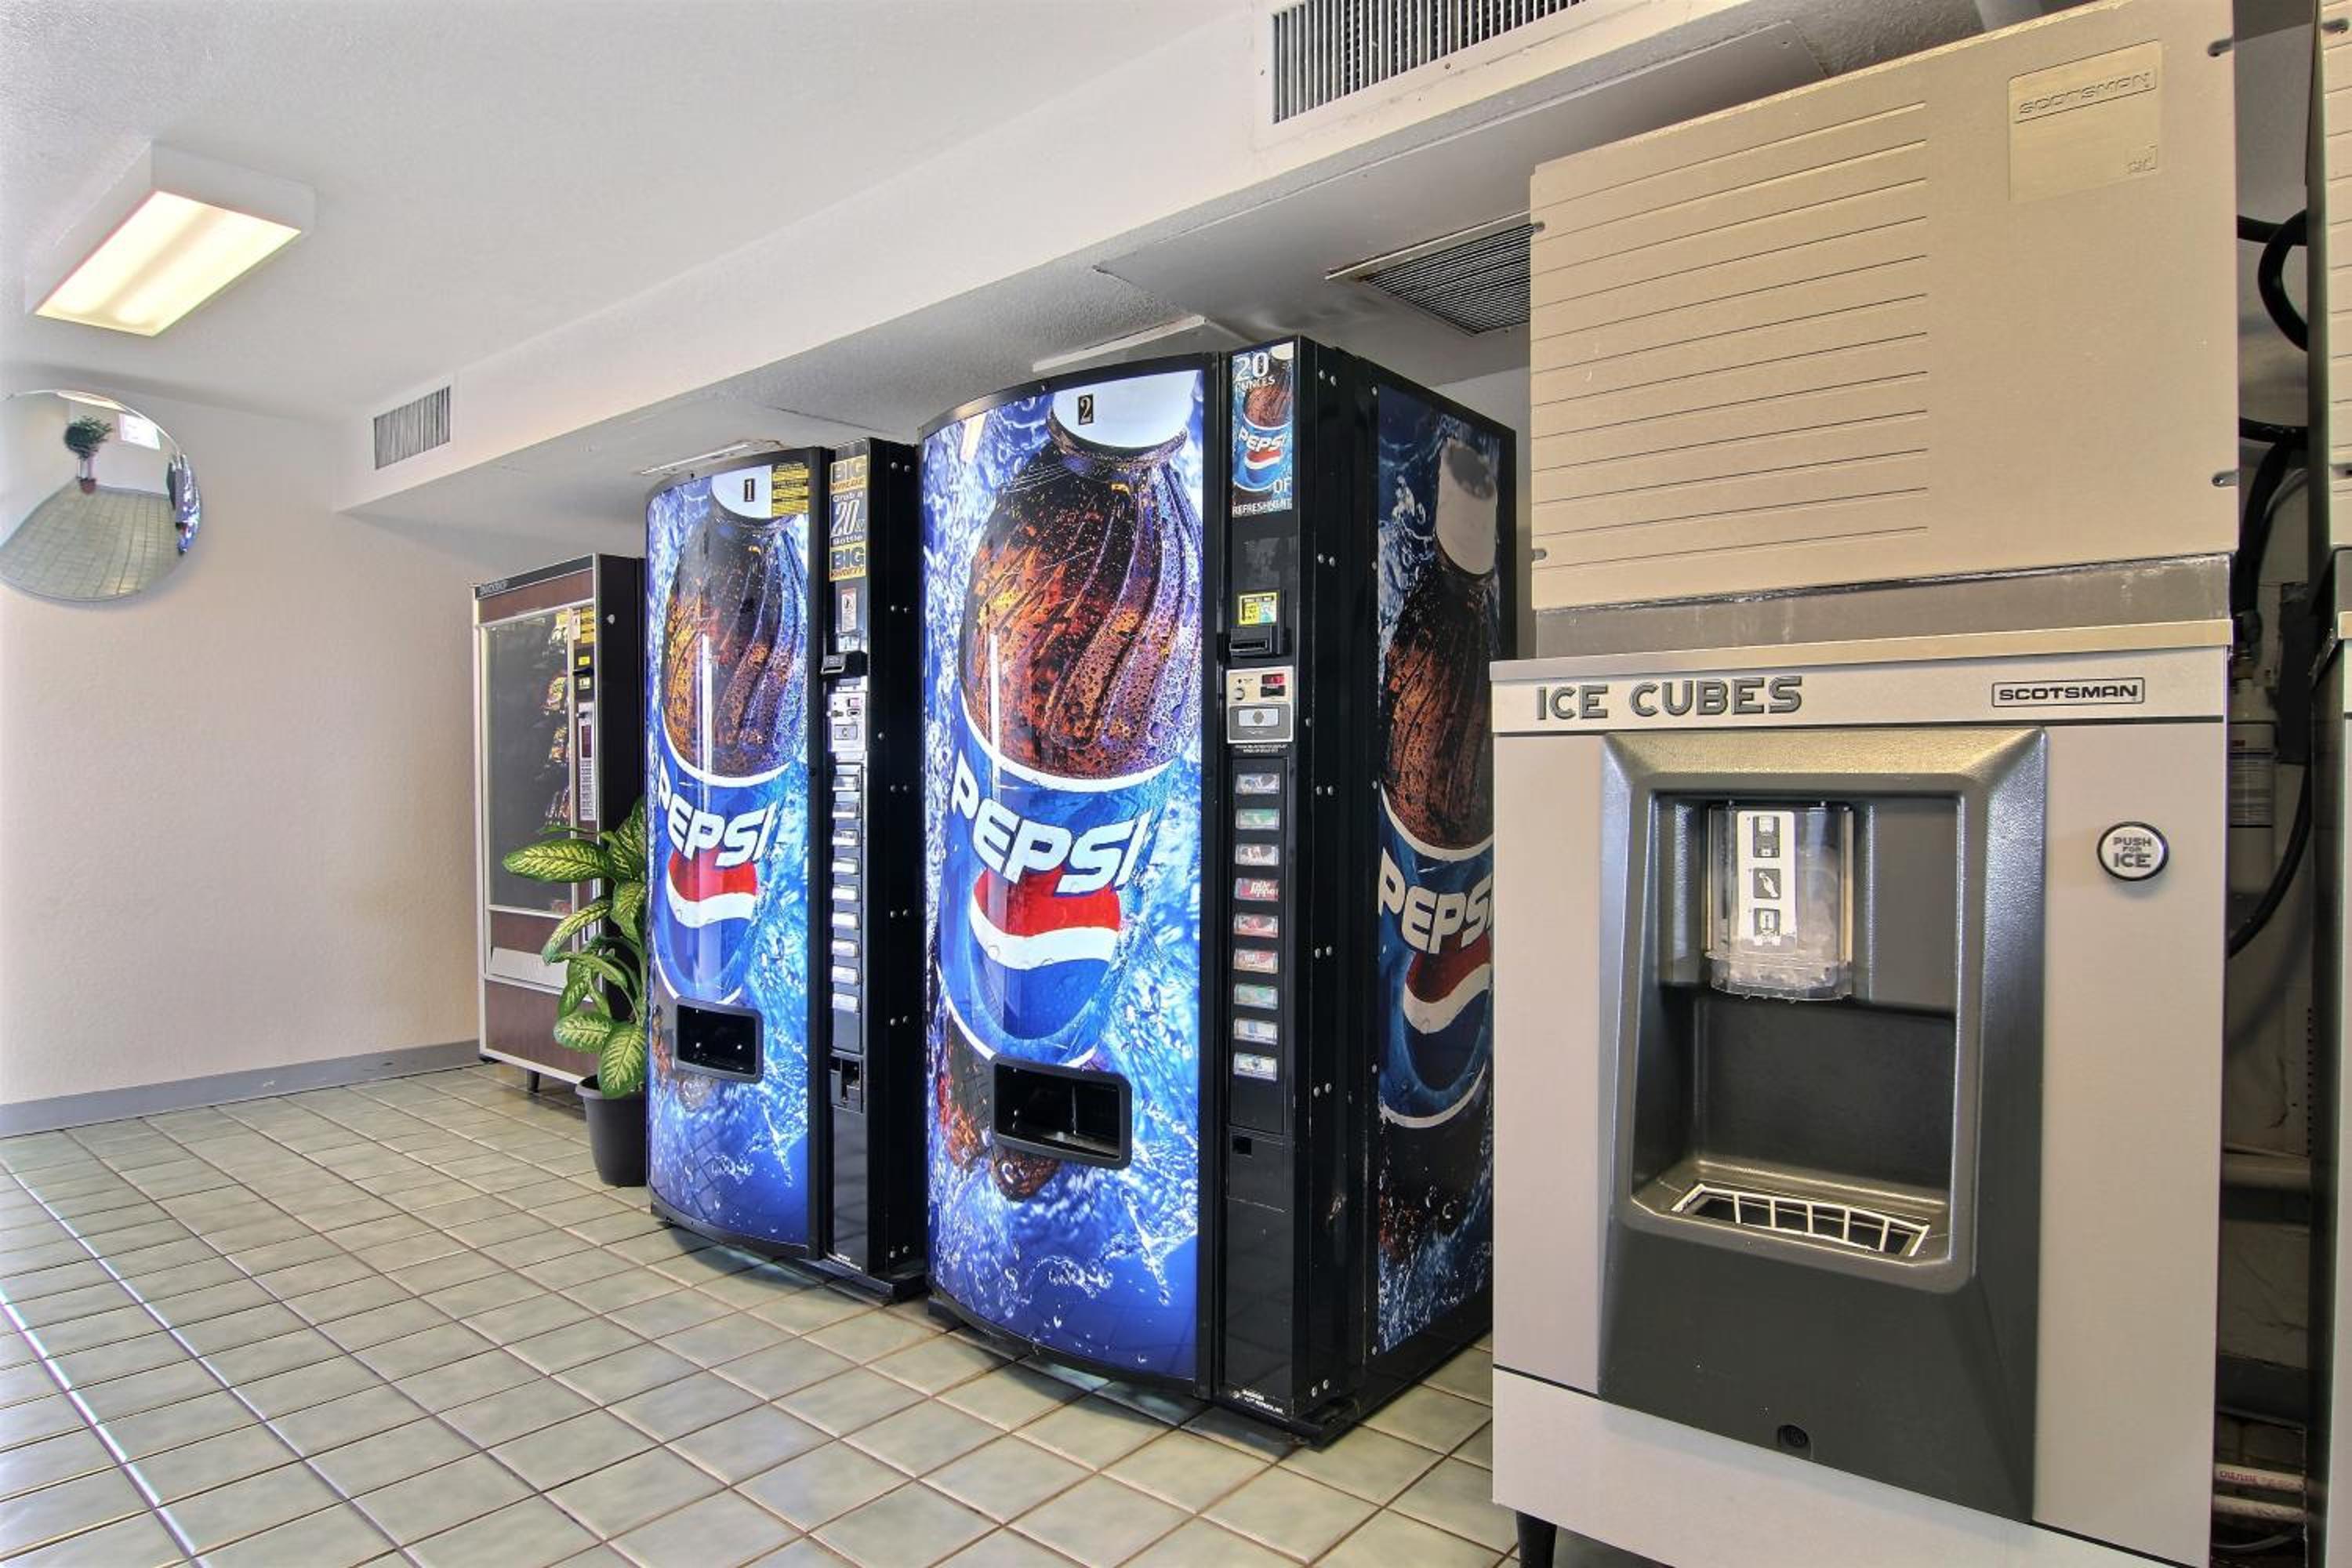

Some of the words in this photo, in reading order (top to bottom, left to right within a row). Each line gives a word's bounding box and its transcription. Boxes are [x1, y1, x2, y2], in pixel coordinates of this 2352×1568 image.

[2019, 72, 2151, 114] SCOTSMAN
[1235, 352, 1269, 382] 20
[1079, 396, 1092, 424] 2
[1238, 426, 1286, 452] PEPSI
[832, 459, 866, 483] BIG
[745, 480, 753, 501] 1
[1272, 477, 1292, 494] OF
[831, 499, 860, 537] 20
[831, 547, 865, 570] BIG
[1537, 684, 1608, 720] ICE
[1630, 676, 1802, 717] CUBES
[1999, 684, 2139, 701] SCOTSMAN
[658, 755, 779, 866] PEPSI
[951, 749, 1153, 894] PEPSI
[2113, 837, 2151, 847] PUSH
[2114, 852, 2151, 868] ICE
